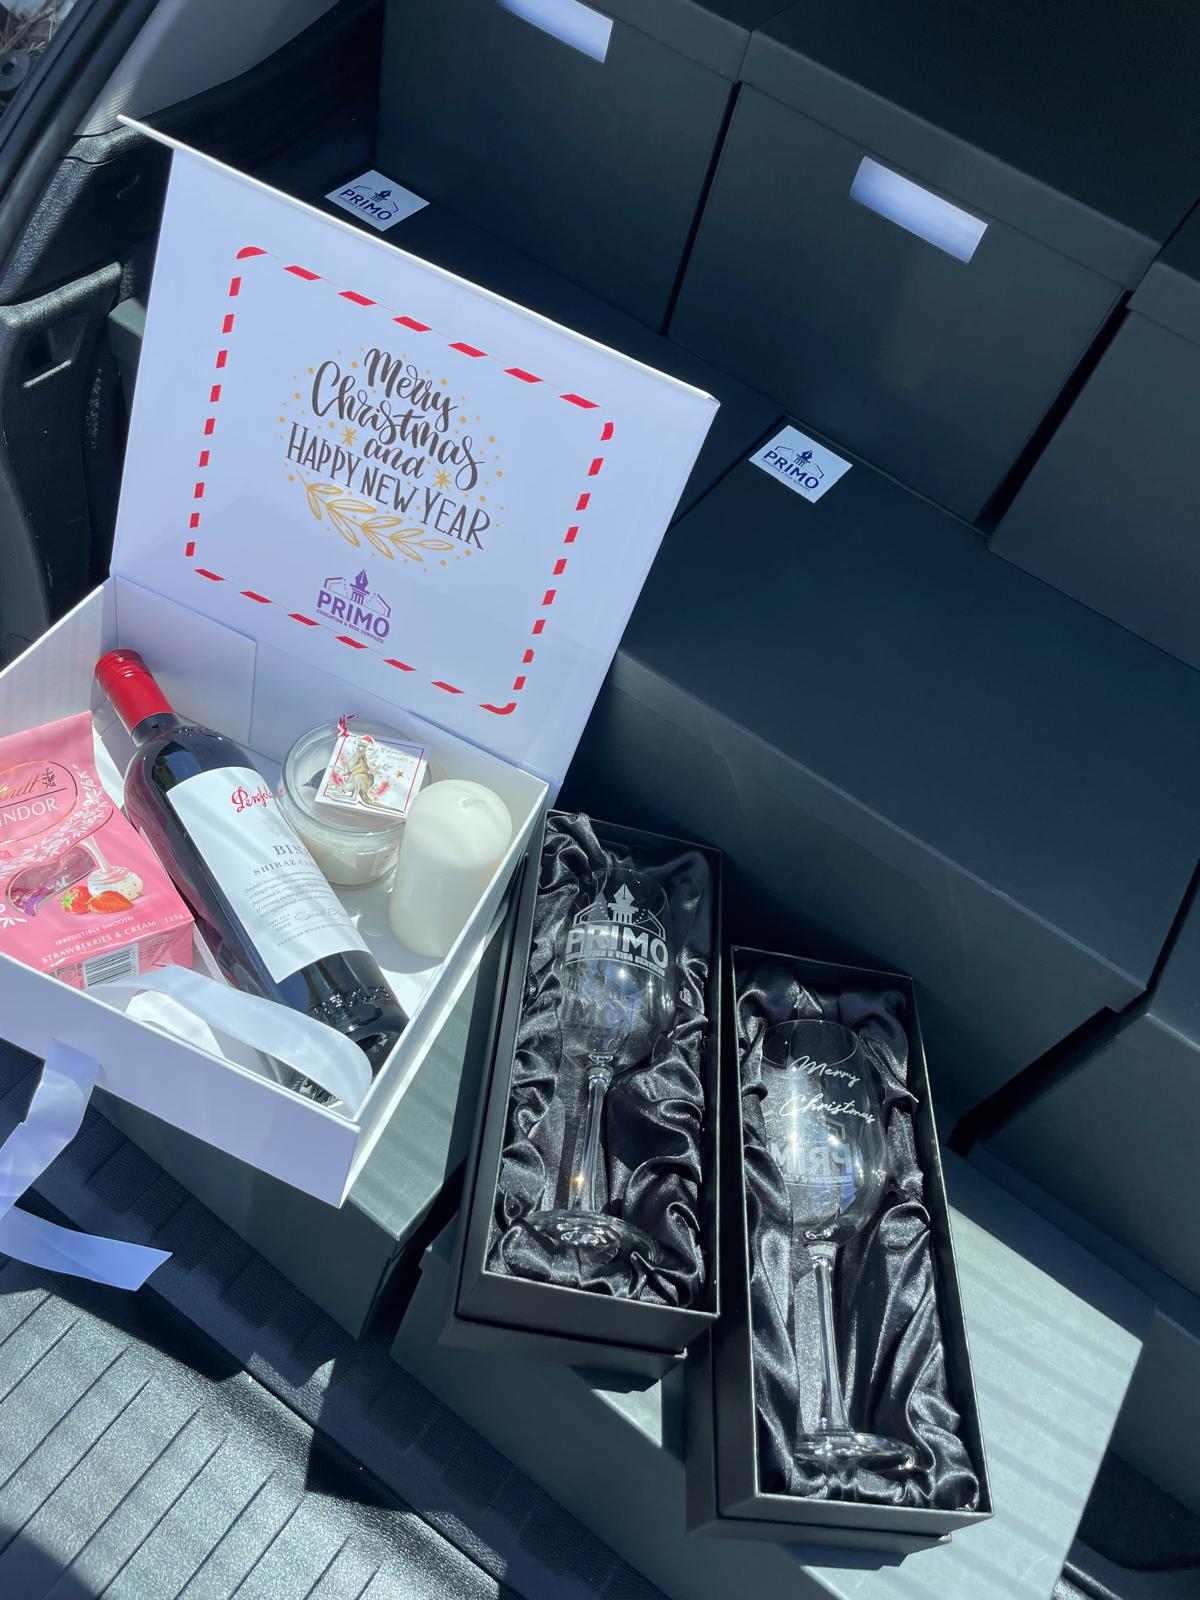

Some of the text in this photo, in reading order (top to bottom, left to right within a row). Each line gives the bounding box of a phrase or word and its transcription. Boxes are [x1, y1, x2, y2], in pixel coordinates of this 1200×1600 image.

[340, 189, 392, 220] PRIMO
[363, 347, 458, 433] Merry
[311, 360, 485, 491] Christmas
[363, 438, 425, 479] and
[764, 450, 819, 489] PRIMO
[286, 420, 490, 550] HAPPY NEW YEAR
[316, 590, 390, 638] PRIMO
[0, 797, 58, 827] NDOR
[253, 859, 296, 876] SHIRAZ
[41, 934, 112, 964] STRAWBERRIES
[115, 931, 122, 939] &
[124, 920, 157, 936] CREAM
[55, 915, 134, 945] IRRESISTIBLY SMOOTH
[565, 924, 669, 969] PRIMO
[789, 1055, 860, 1088] Merry
[780, 1092, 876, 1124] Christmas
